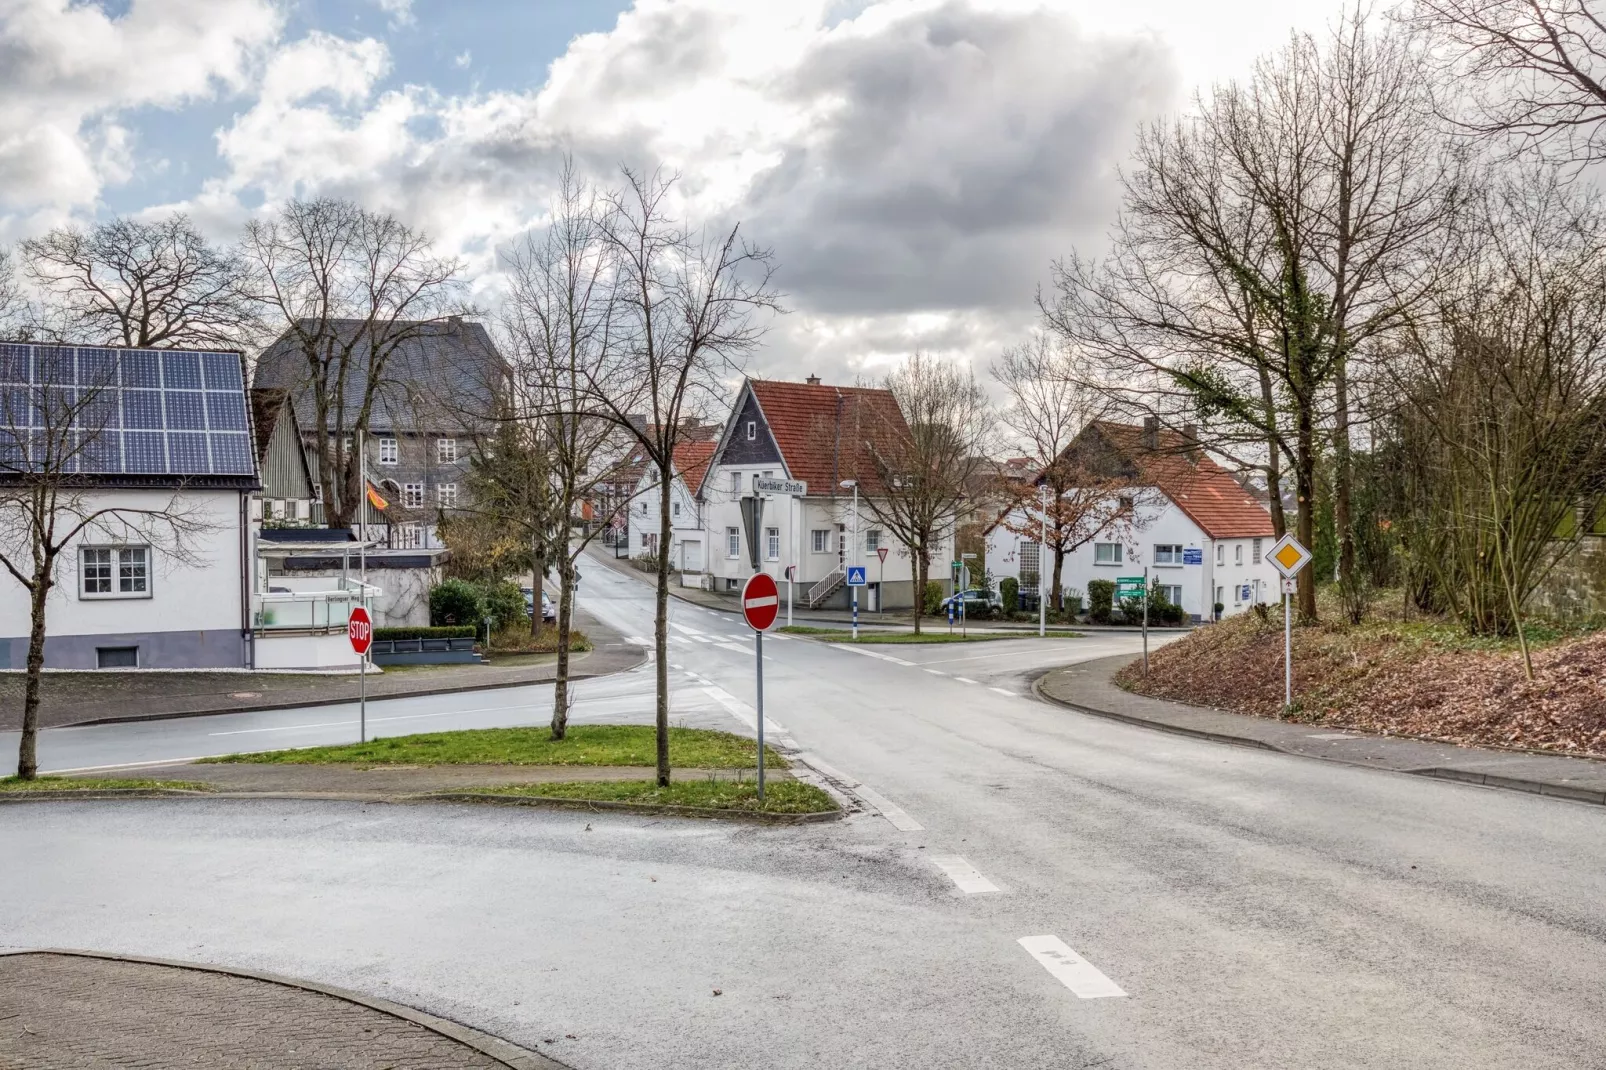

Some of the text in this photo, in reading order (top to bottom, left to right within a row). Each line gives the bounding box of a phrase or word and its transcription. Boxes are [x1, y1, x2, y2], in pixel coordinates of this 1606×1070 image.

[758, 480, 802, 492] Küerbiker Straße
[350, 620, 370, 641] STOP
